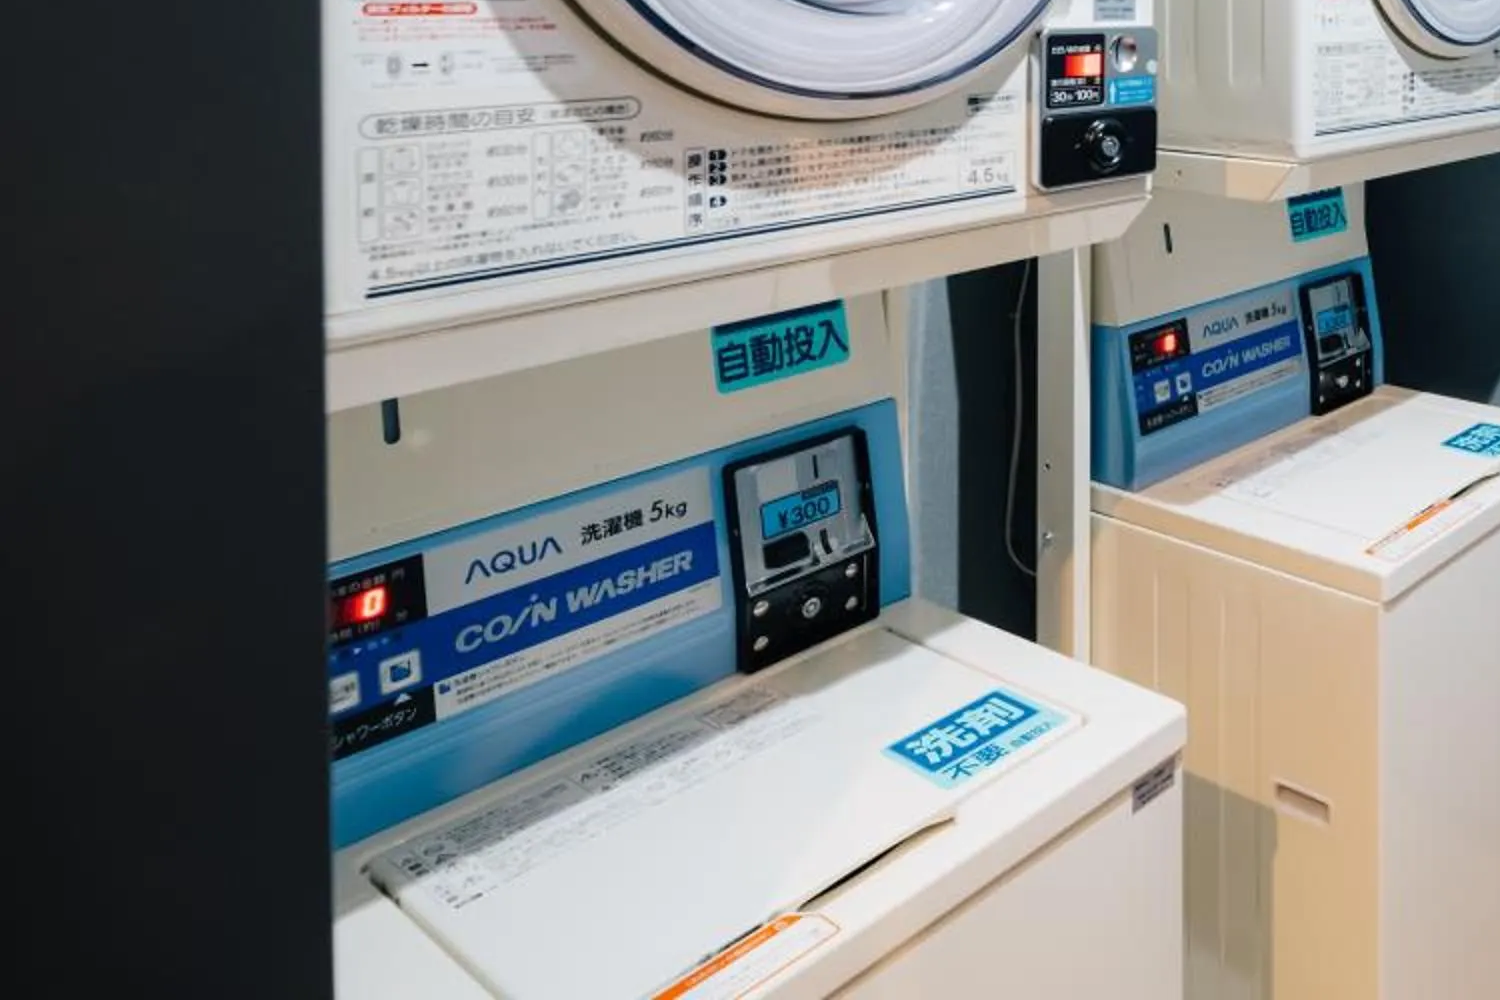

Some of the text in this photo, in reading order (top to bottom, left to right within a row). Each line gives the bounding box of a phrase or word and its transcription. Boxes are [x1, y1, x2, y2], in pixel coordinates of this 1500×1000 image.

[716, 318, 849, 385] 自動投入
[580, 499, 689, 546] 洗濯機 5kg
[777, 497, 831, 529] ¥300
[464, 536, 563, 585] AQUA
[454, 593, 558, 654] COIN
[566, 550, 695, 614] WASHER
[905, 696, 1026, 765] 洗剤
